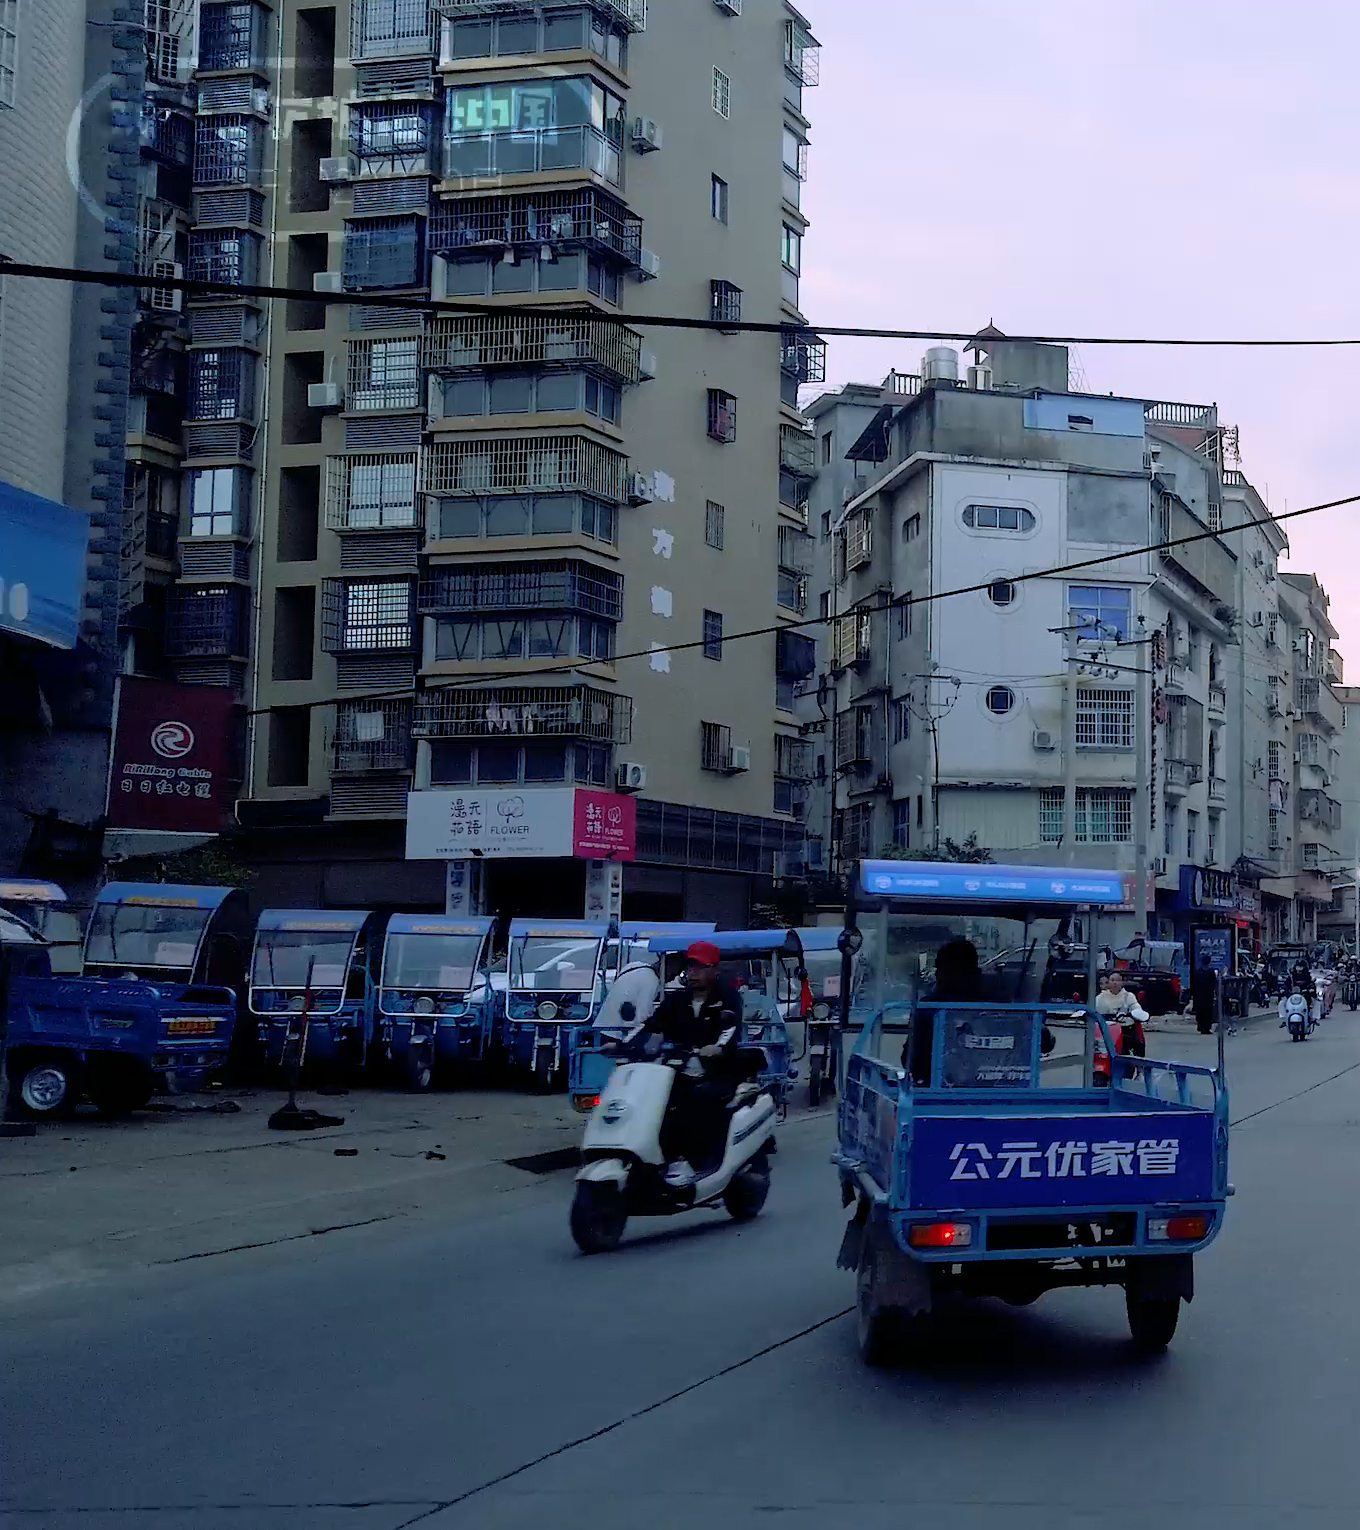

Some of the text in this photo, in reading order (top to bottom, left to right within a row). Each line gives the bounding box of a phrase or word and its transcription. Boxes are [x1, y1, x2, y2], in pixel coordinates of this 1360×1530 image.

[121, 778, 212, 799] 日日红电缆
[490, 825, 529, 835] FLOWER
[604, 827, 624, 836] FLOWER
[948, 1138, 1180, 1181] 公元优家管
